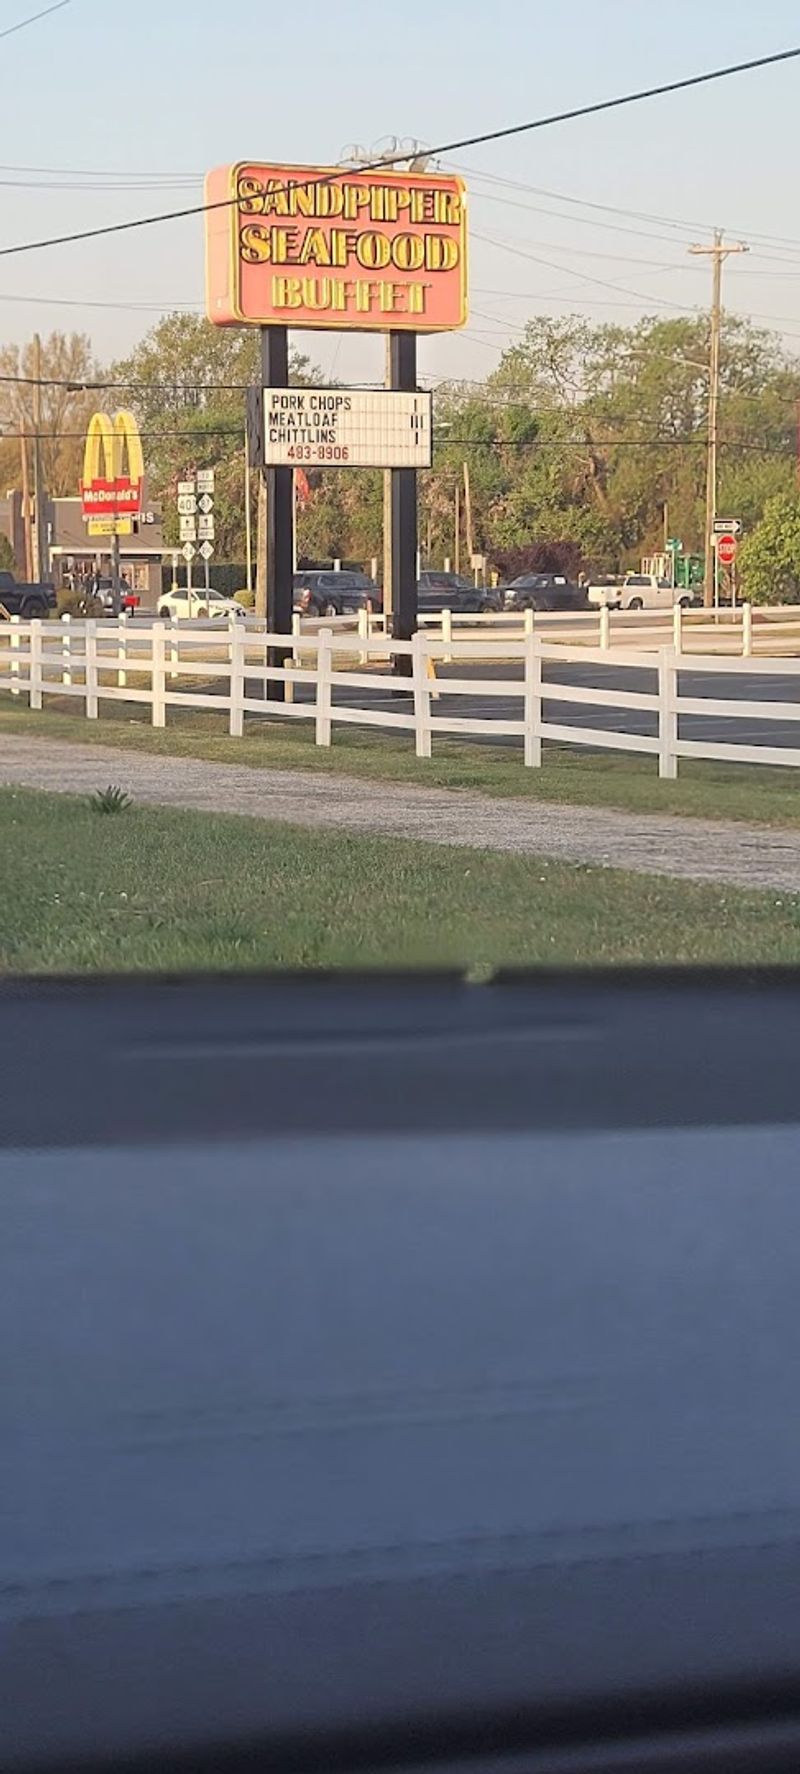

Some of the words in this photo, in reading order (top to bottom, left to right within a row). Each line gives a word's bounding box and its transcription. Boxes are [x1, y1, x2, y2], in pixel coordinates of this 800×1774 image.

[237, 177, 461, 224] SANDPIPER
[240, 224, 459, 271] SEAFOOD
[271, 275, 431, 314] BUFFET
[271, 395, 305, 410] PORK
[310, 396, 352, 411] CHOPS
[269, 412, 338, 427] MEATLOAF
[269, 428, 336, 443] CHITTLINS
[287, 446, 349, 460] 483-8906
[85, 490, 138, 503] McDonald's
